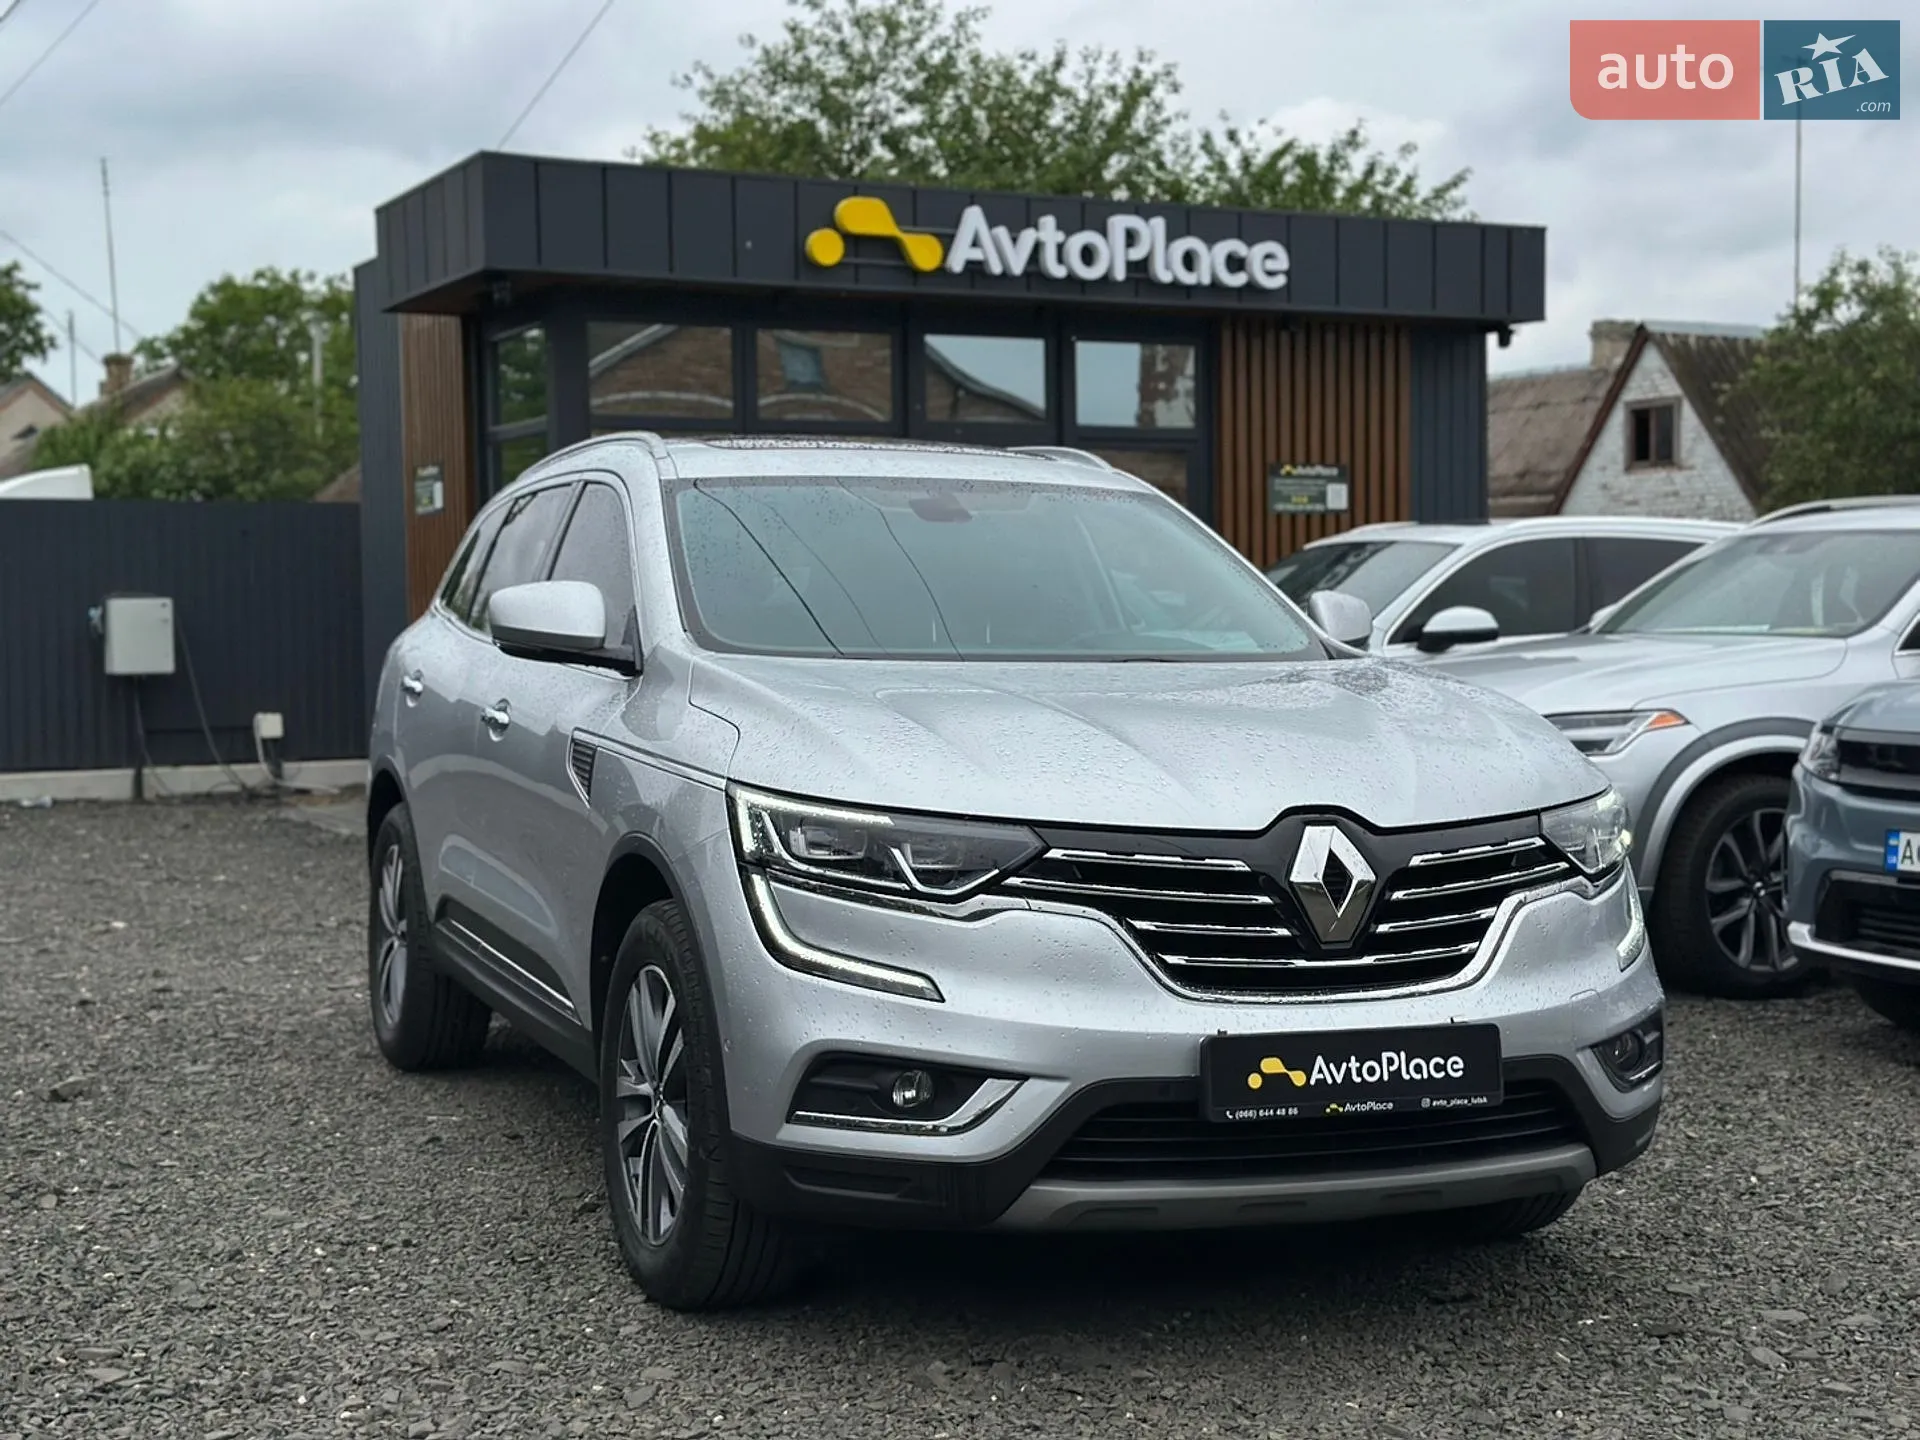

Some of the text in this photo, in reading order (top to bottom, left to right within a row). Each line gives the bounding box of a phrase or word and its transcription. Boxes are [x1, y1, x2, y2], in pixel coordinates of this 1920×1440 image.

[944, 204, 1290, 290] AvtoPlace
[1309, 1050, 1464, 1086] AvtoPlace
[1344, 1101, 1394, 1112] AvtoPlace
